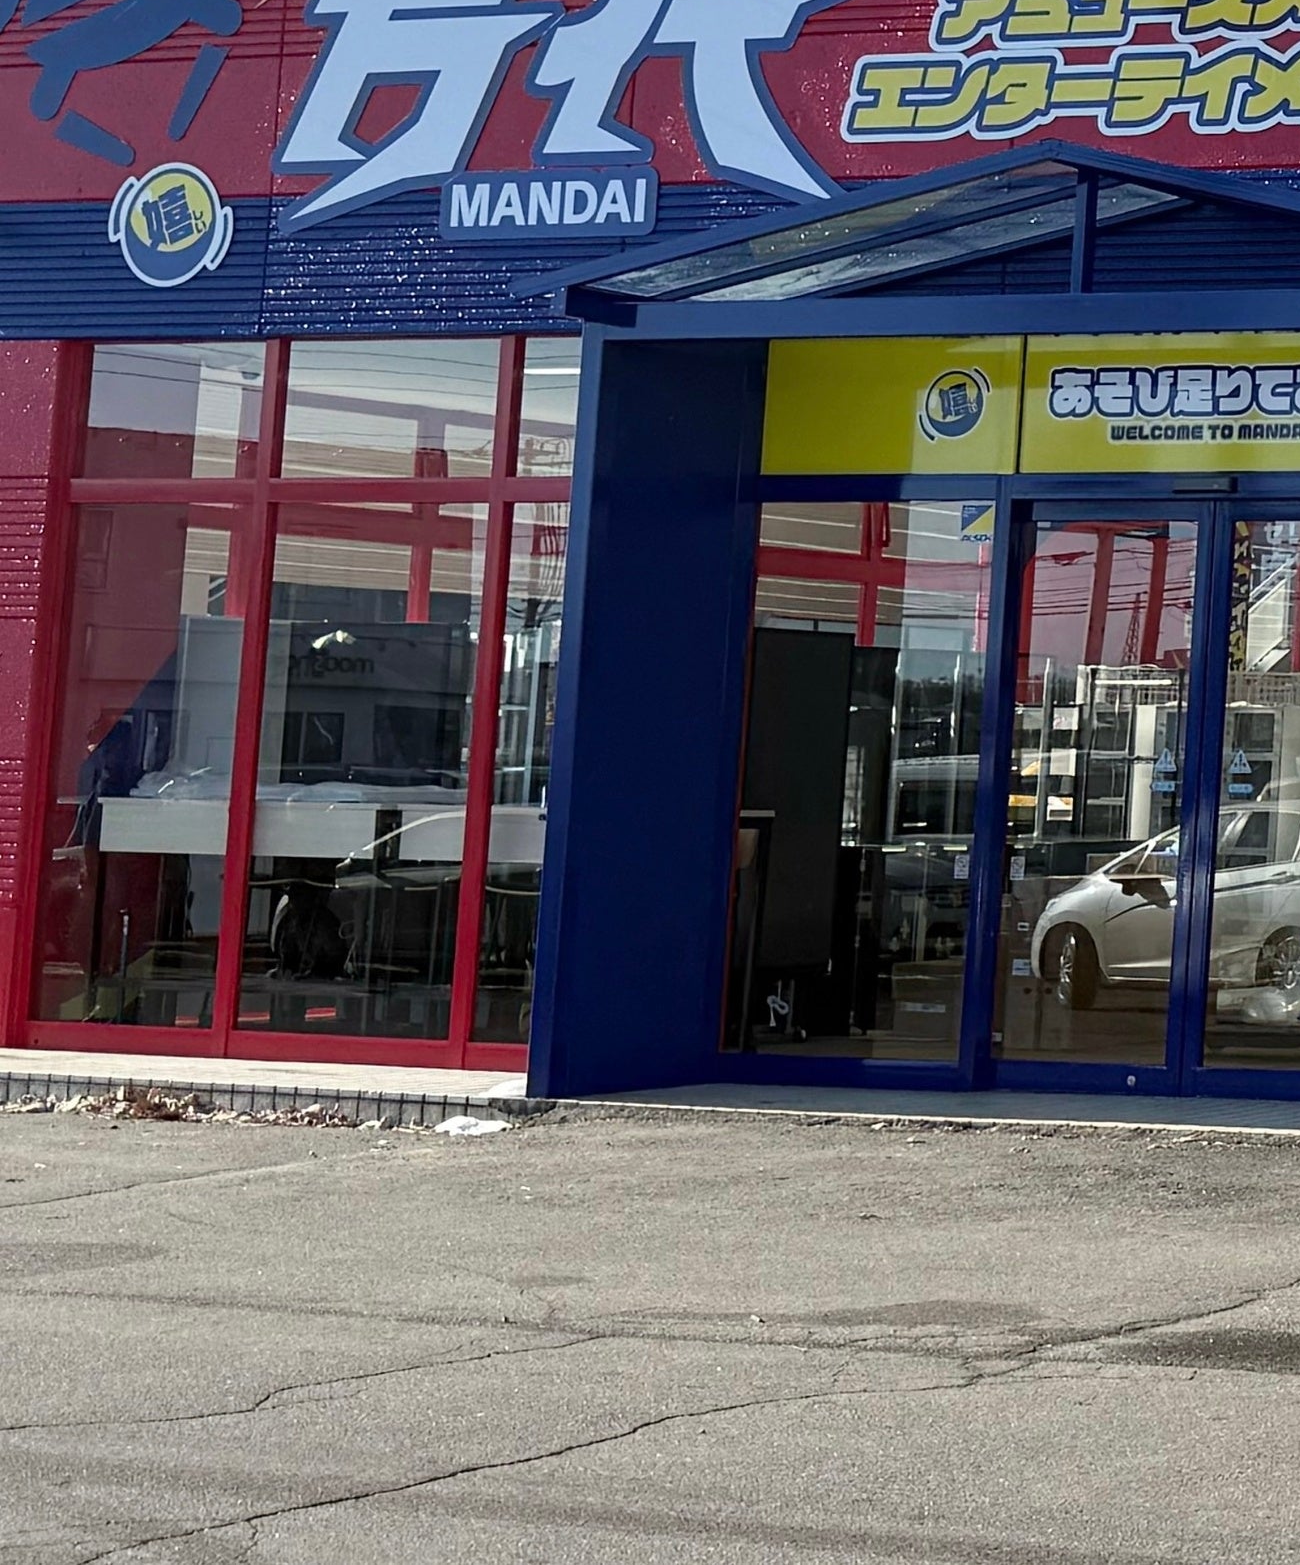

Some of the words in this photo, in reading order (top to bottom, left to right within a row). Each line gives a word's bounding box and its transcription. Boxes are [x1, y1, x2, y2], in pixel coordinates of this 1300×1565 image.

[449, 177, 647, 228] MANDAI
[1110, 423, 1204, 441] WELCOME
[1207, 423, 1233, 440] TO
